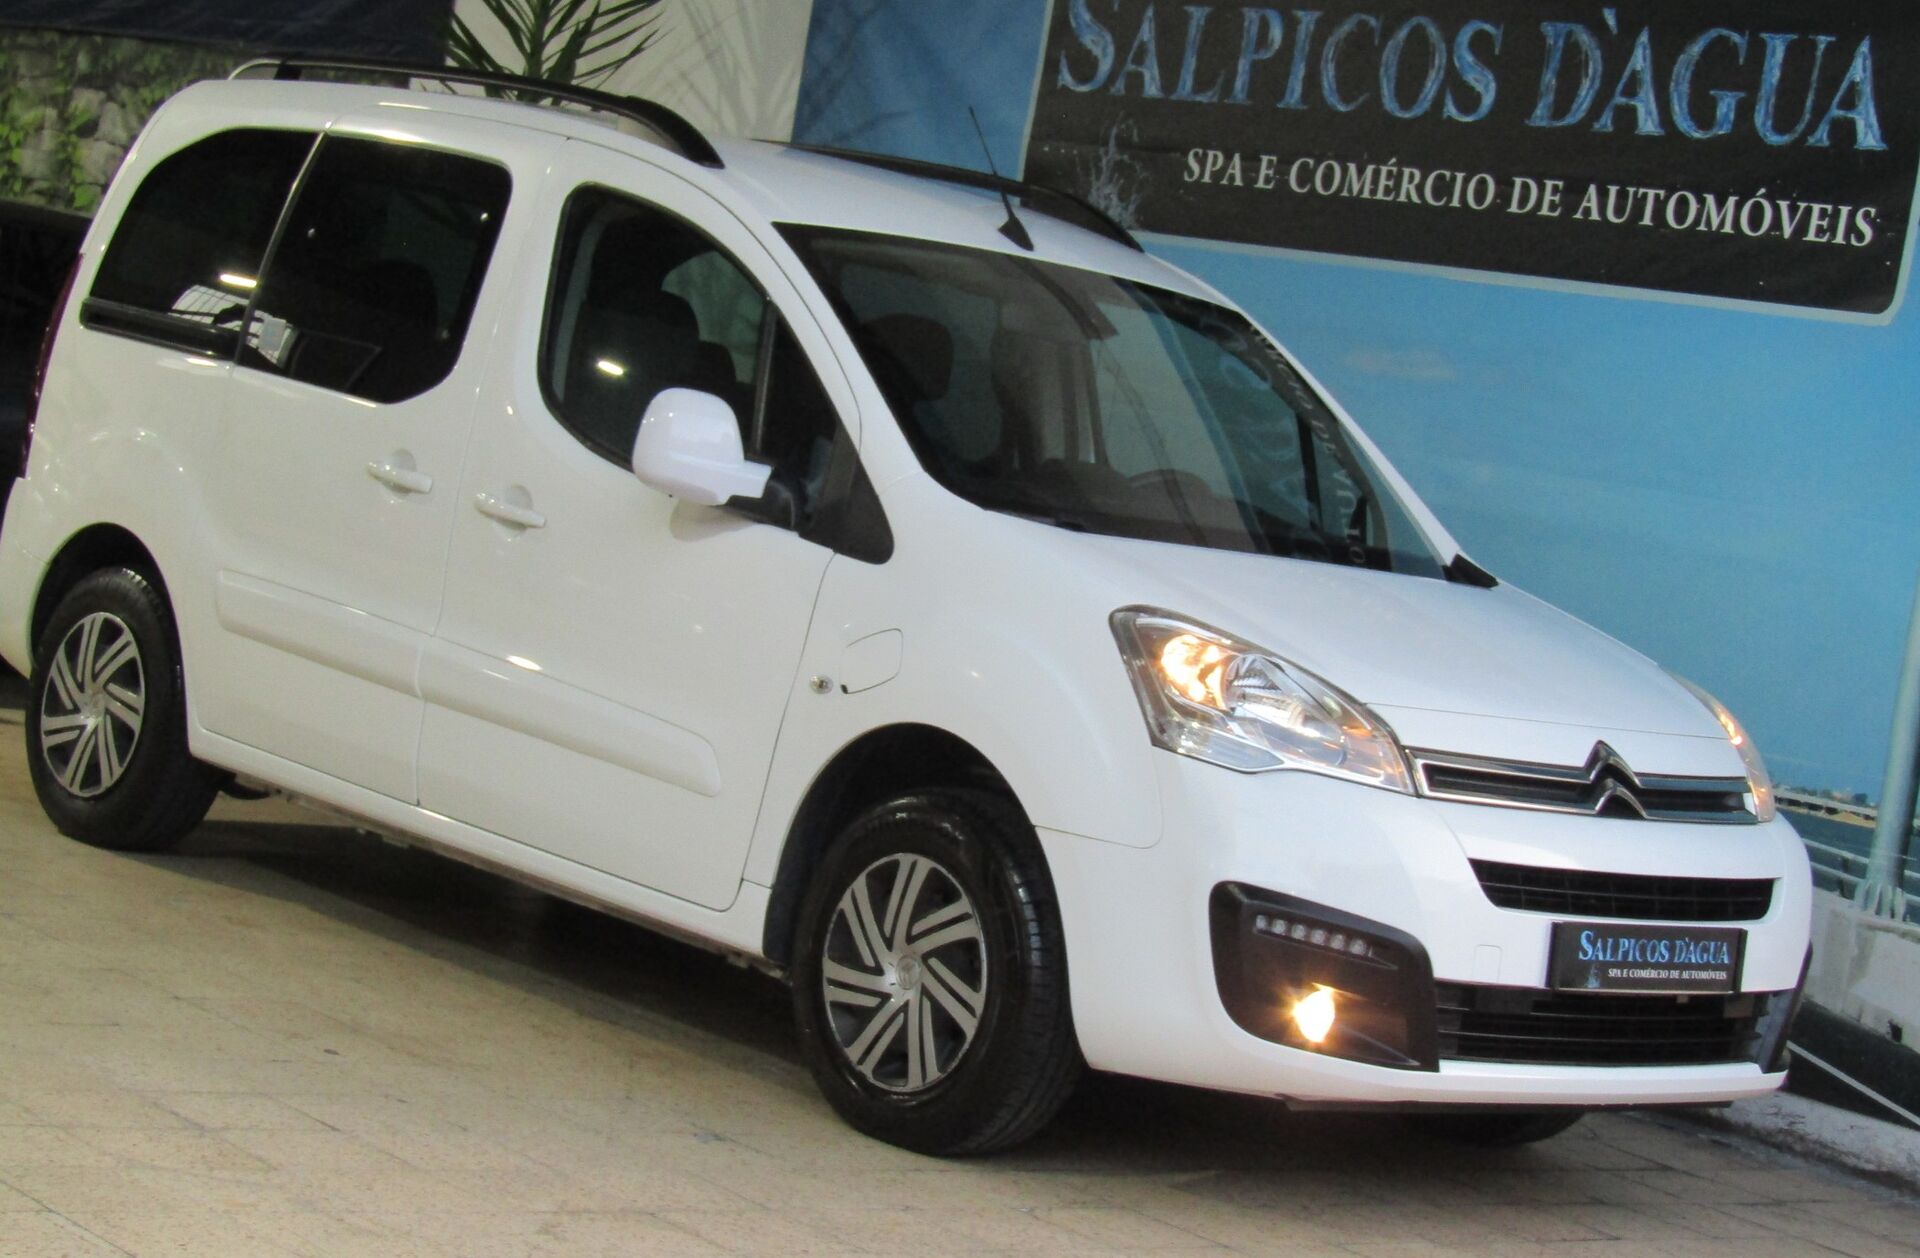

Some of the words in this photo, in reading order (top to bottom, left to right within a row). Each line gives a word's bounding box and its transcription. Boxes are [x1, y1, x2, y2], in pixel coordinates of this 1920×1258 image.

[1057, 0, 1504, 122] SALPICOS
[1184, 147, 1244, 187] SPA
[1254, 154, 1278, 190] E
[1288, 156, 1496, 211] COMÉRCIO
[1506, 175, 1564, 217] DE
[1572, 182, 1877, 248] AUTOMÓVEIS
[1578, 930, 1670, 963] SALPICOS
[1608, 968, 1621, 978] SPA
[1623, 968, 1628, 978] E
[1629, 967, 1669, 979] COMÉRCIO
[1669, 969, 1680, 979] DE
[1681, 969, 1728, 980] AUTOMÓVEIS
